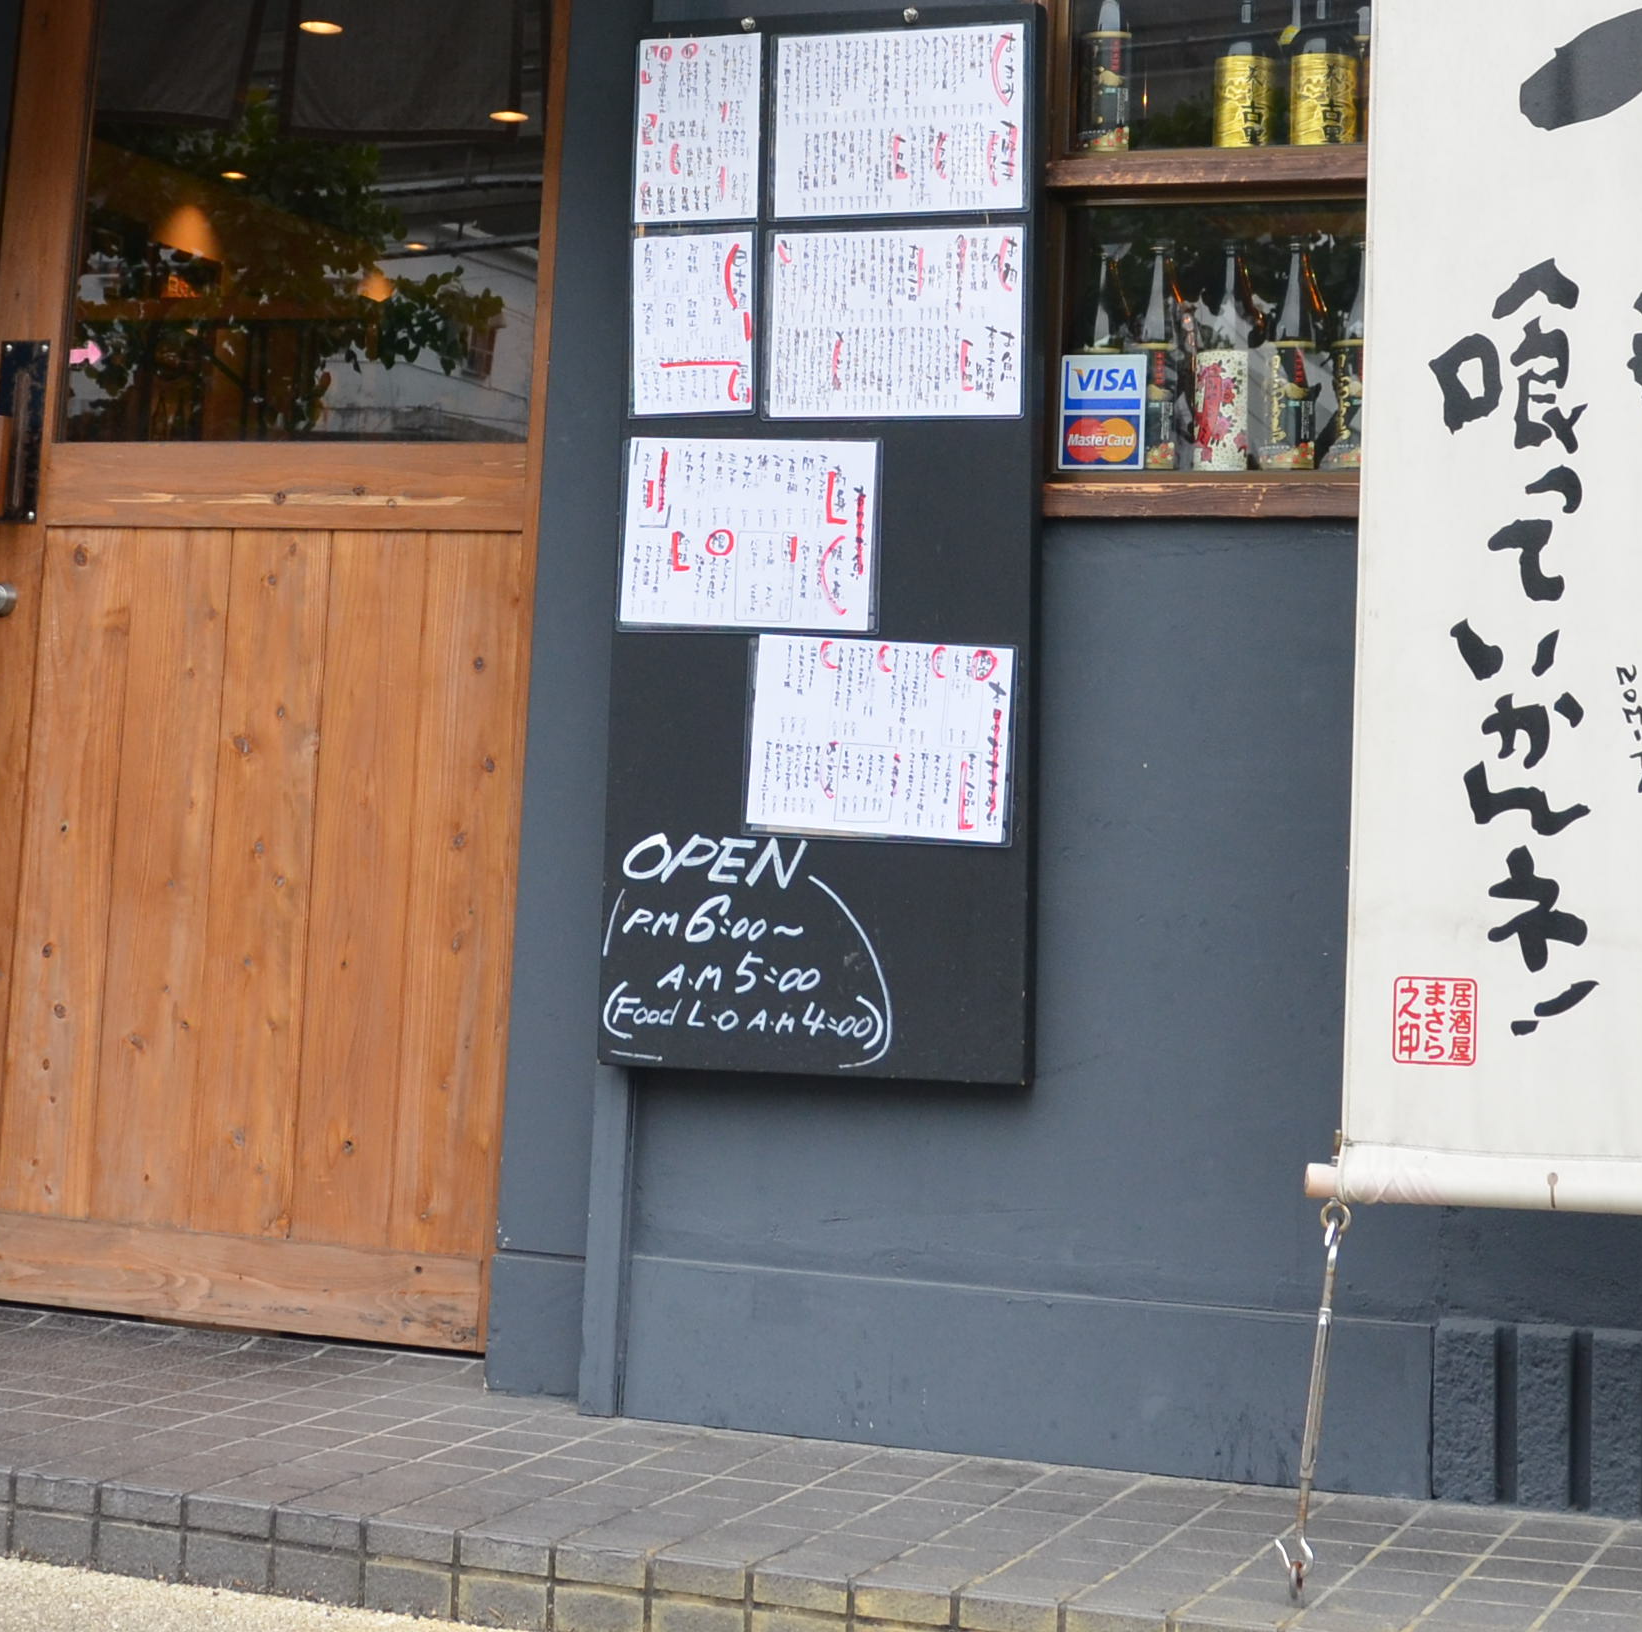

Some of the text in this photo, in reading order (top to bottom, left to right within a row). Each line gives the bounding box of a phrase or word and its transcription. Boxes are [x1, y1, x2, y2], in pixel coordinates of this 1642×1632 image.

[1072, 367, 1138, 392] VISA
[1067, 432, 1135, 448] MasterCard
[621, 831, 808, 890] OPEN
[734, 950, 822, 995] 5:00
[1424, 981, 1446, 1060] まさら
[1448, 982, 1473, 1062] 居酒屋
